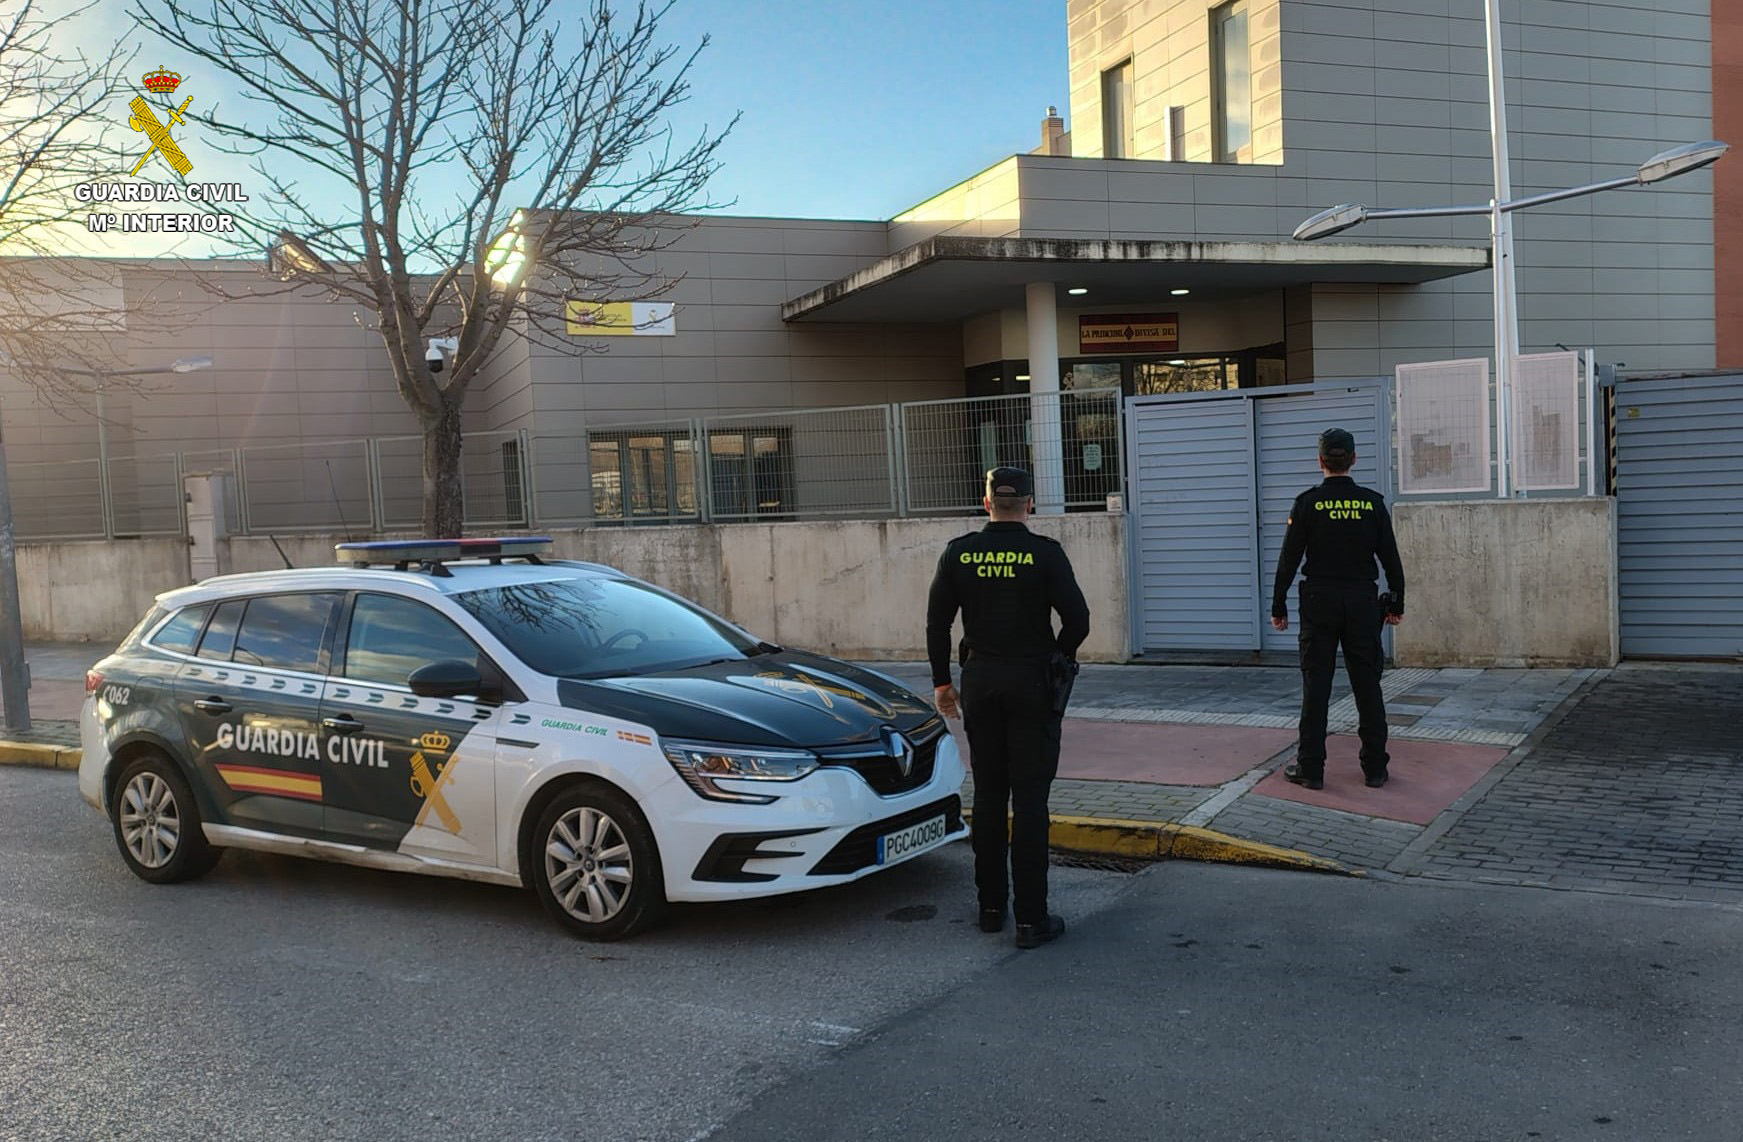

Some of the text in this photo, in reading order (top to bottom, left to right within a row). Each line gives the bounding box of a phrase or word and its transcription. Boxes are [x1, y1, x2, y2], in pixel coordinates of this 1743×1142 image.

[1314, 500, 1374, 511] GUARDIA
[1329, 510, 1361, 520] CIVIL
[960, 551, 1034, 565] GUARDIA
[977, 565, 1016, 578] CIVIL
[541, 718, 609, 737] GUARDIA CIVIL
[216, 722, 389, 769] GUARDIA CIVIL
[886, 819, 944, 859] PGC4009G
